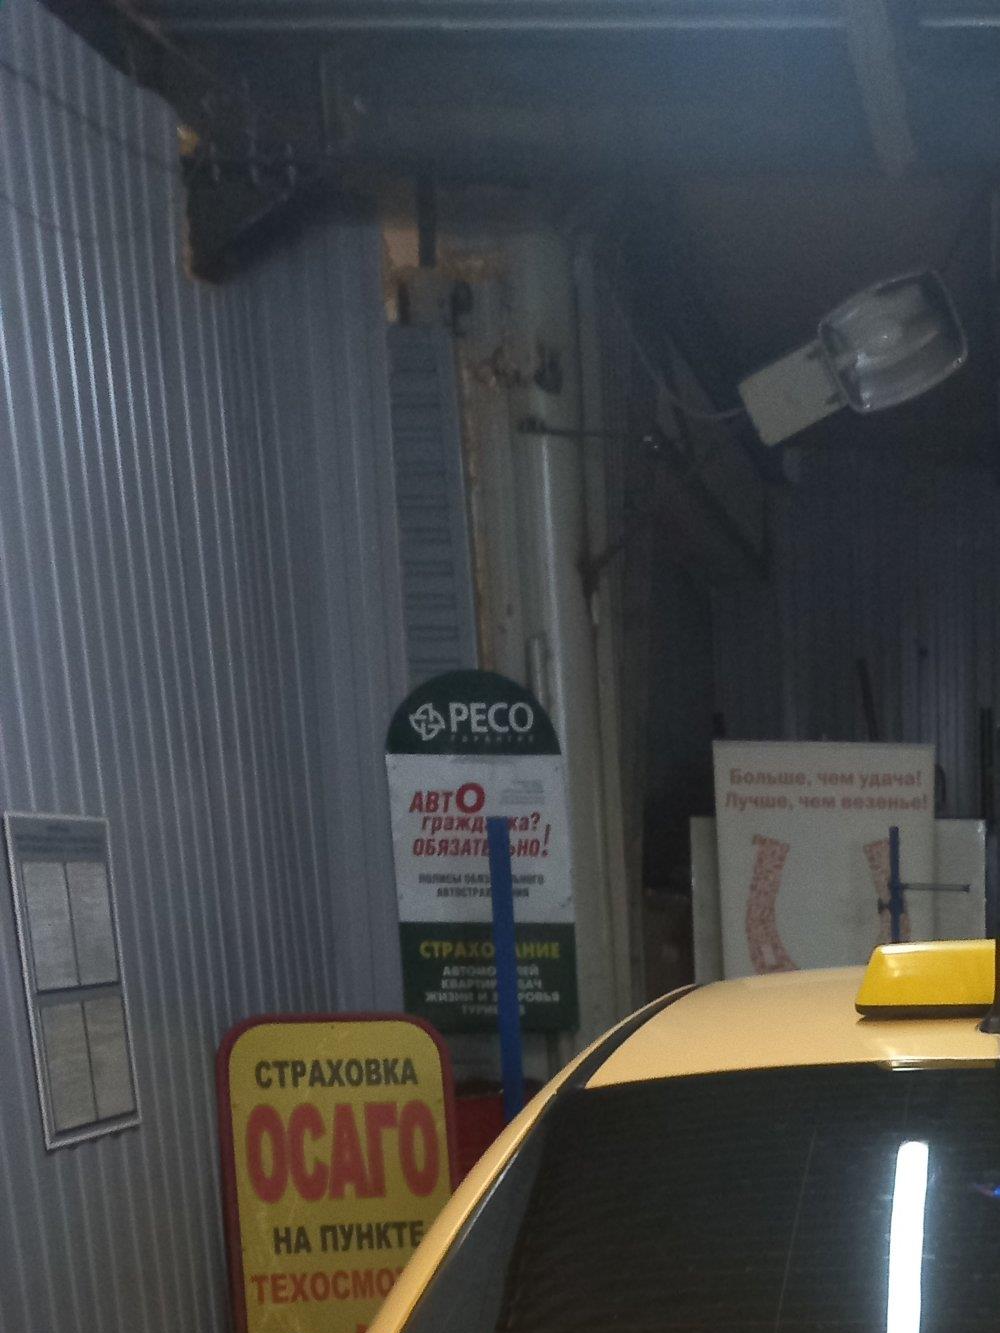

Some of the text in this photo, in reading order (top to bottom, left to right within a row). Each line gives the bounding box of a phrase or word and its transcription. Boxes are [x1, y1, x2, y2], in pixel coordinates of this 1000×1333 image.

[449, 702, 535, 734] РЕСО
[409, 782, 486, 814] АВТО
[421, 812, 541, 835] граждка?
[255, 1058, 418, 1088] СТРАХОВКА
[246, 1101, 439, 1203] ОСАГО
[273, 1220, 424, 1255] НА ПУНКТЕ
[251, 1267, 403, 1305] ТЕХОСМО
